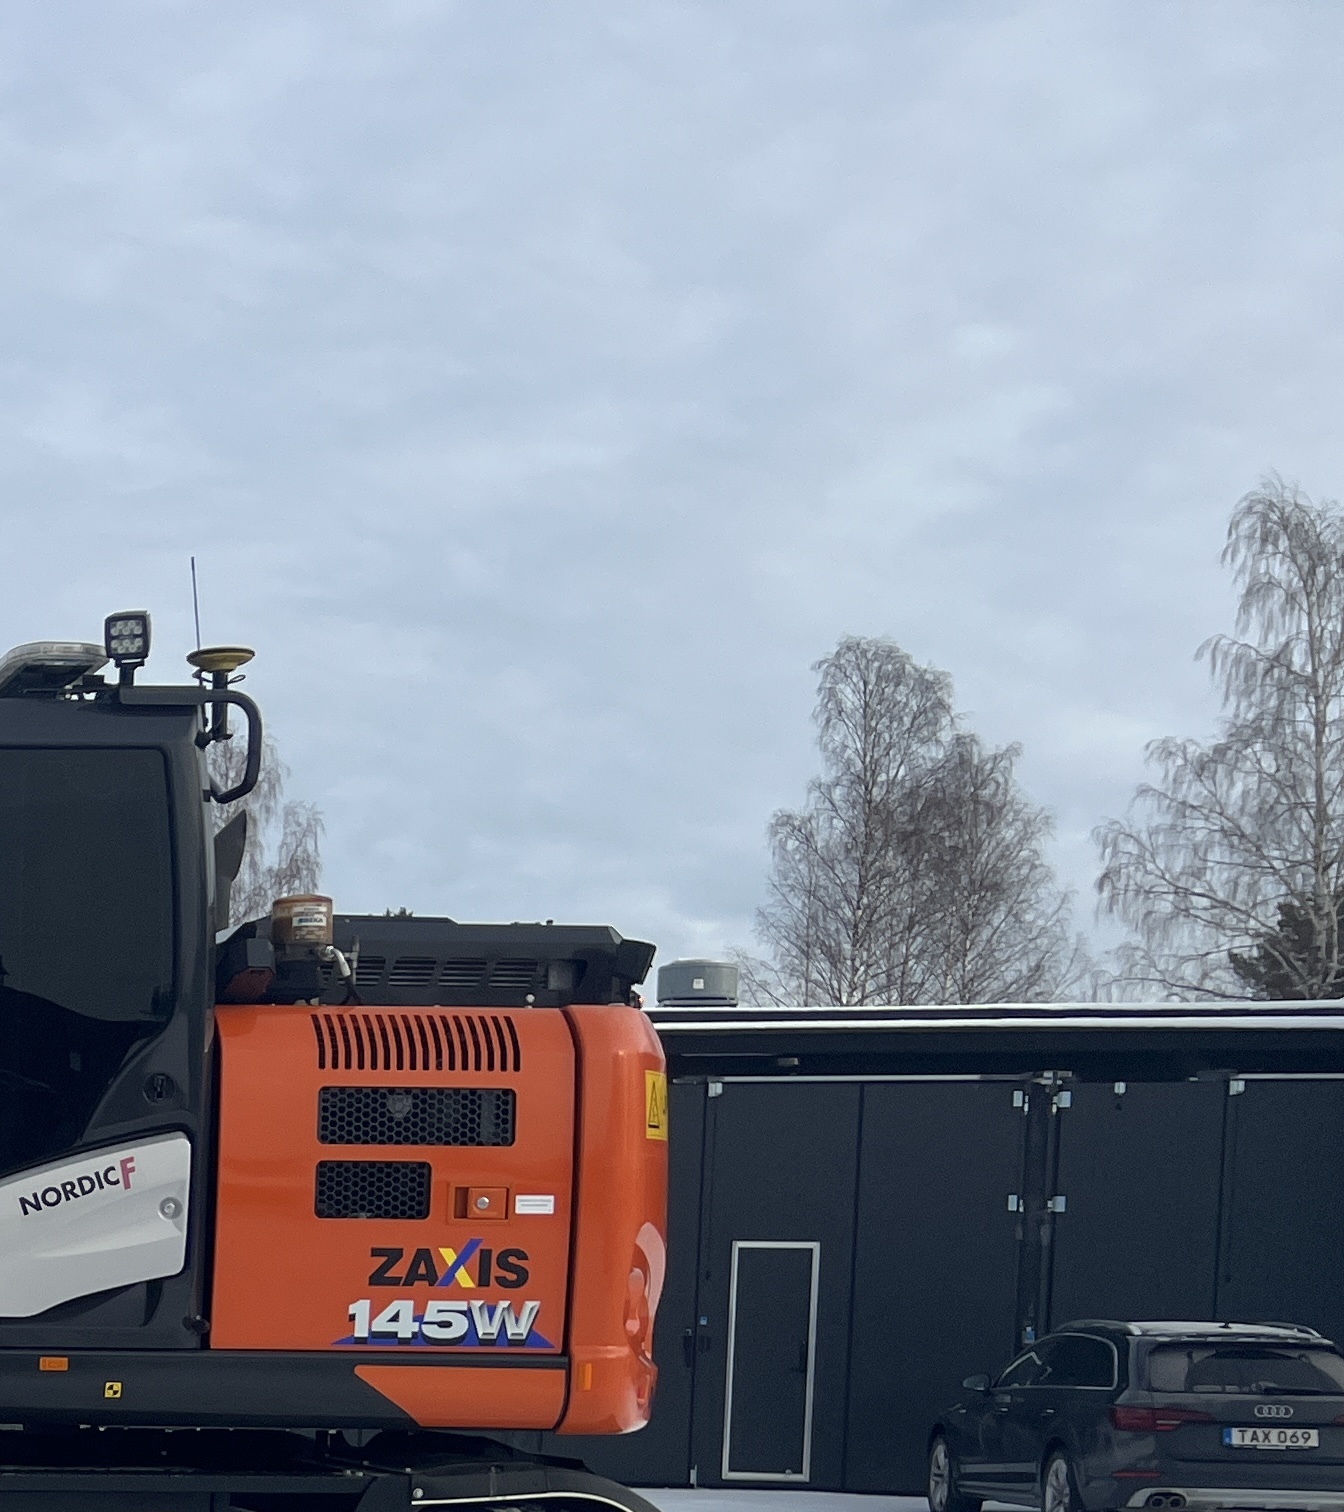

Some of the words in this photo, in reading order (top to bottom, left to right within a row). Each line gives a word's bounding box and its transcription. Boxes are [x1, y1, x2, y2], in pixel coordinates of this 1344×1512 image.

[368, 1238, 530, 1289] ZAXIS
[348, 1299, 542, 1345] 145W
[1237, 1429, 1271, 1443] TAX
[1277, 1430, 1311, 1444] 069
